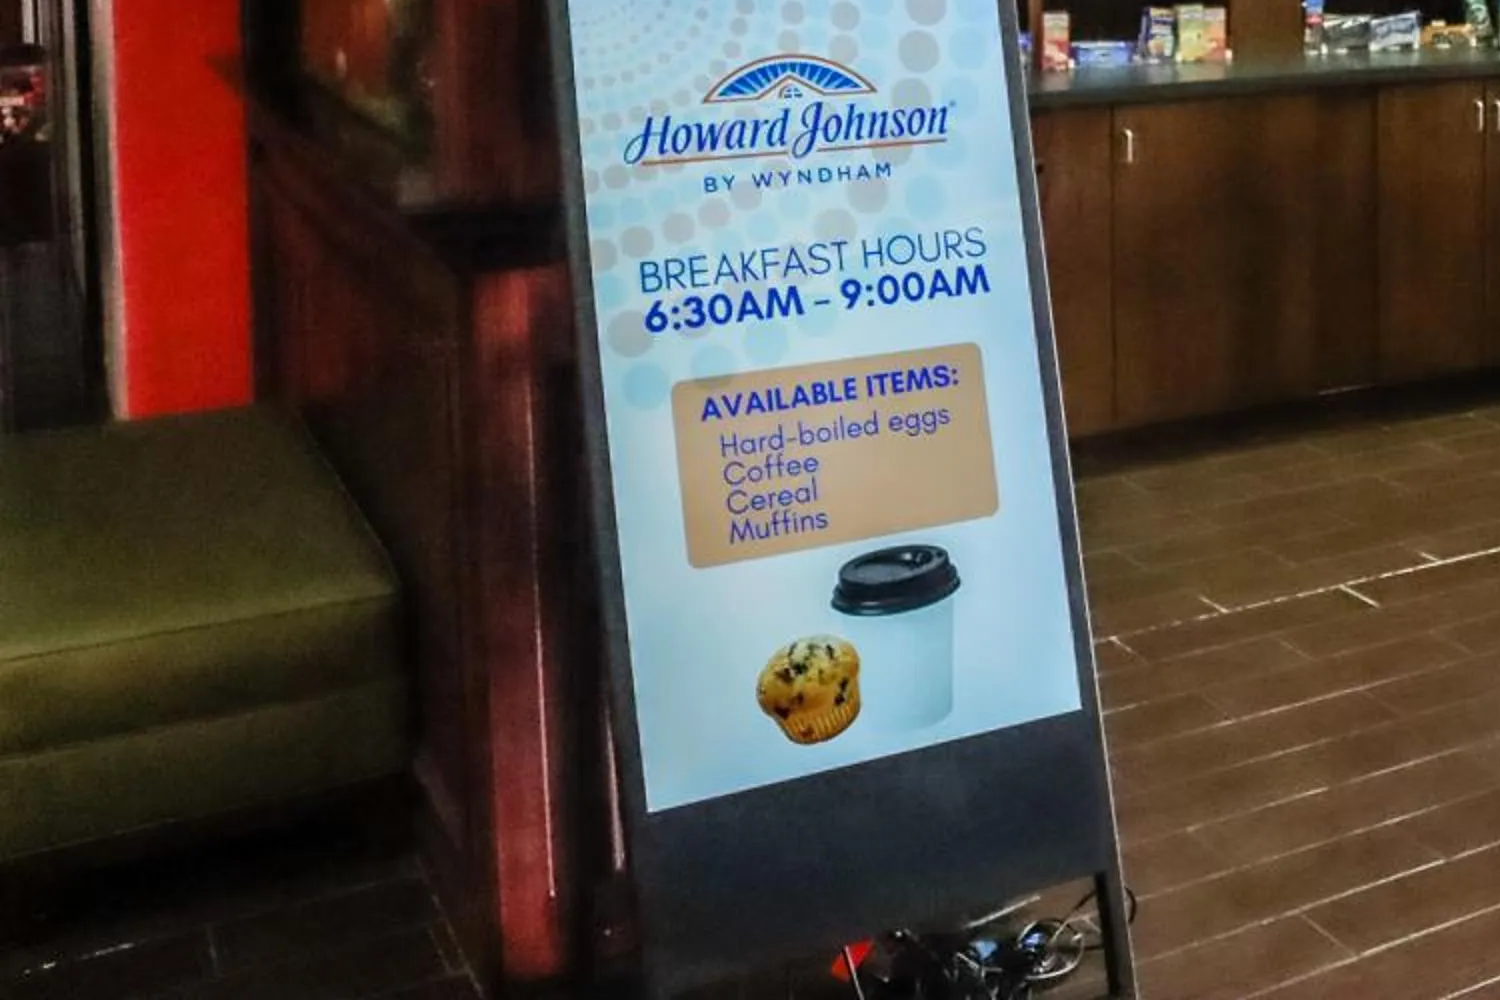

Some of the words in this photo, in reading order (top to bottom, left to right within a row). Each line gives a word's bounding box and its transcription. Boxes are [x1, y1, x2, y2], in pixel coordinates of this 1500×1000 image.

[624, 108, 790, 164] Howard
[792, 101, 948, 158] Johnson
[704, 175, 735, 193] BY
[753, 162, 892, 188] WYNDHAM
[639, 241, 848, 293] BREAKFAST
[862, 227, 987, 268] HOURS
[645, 286, 805, 333] 6:30AM
[840, 264, 991, 309] 9:00AM
[701, 378, 857, 421] AVAILABLE
[866, 365, 959, 397] ITEMS:
[720, 410, 879, 457] Hard-boiled
[888, 408, 951, 436] eggs
[724, 453, 819, 486] Coffee
[726, 476, 818, 515] Cereal
[730, 511, 829, 544] Muffins
